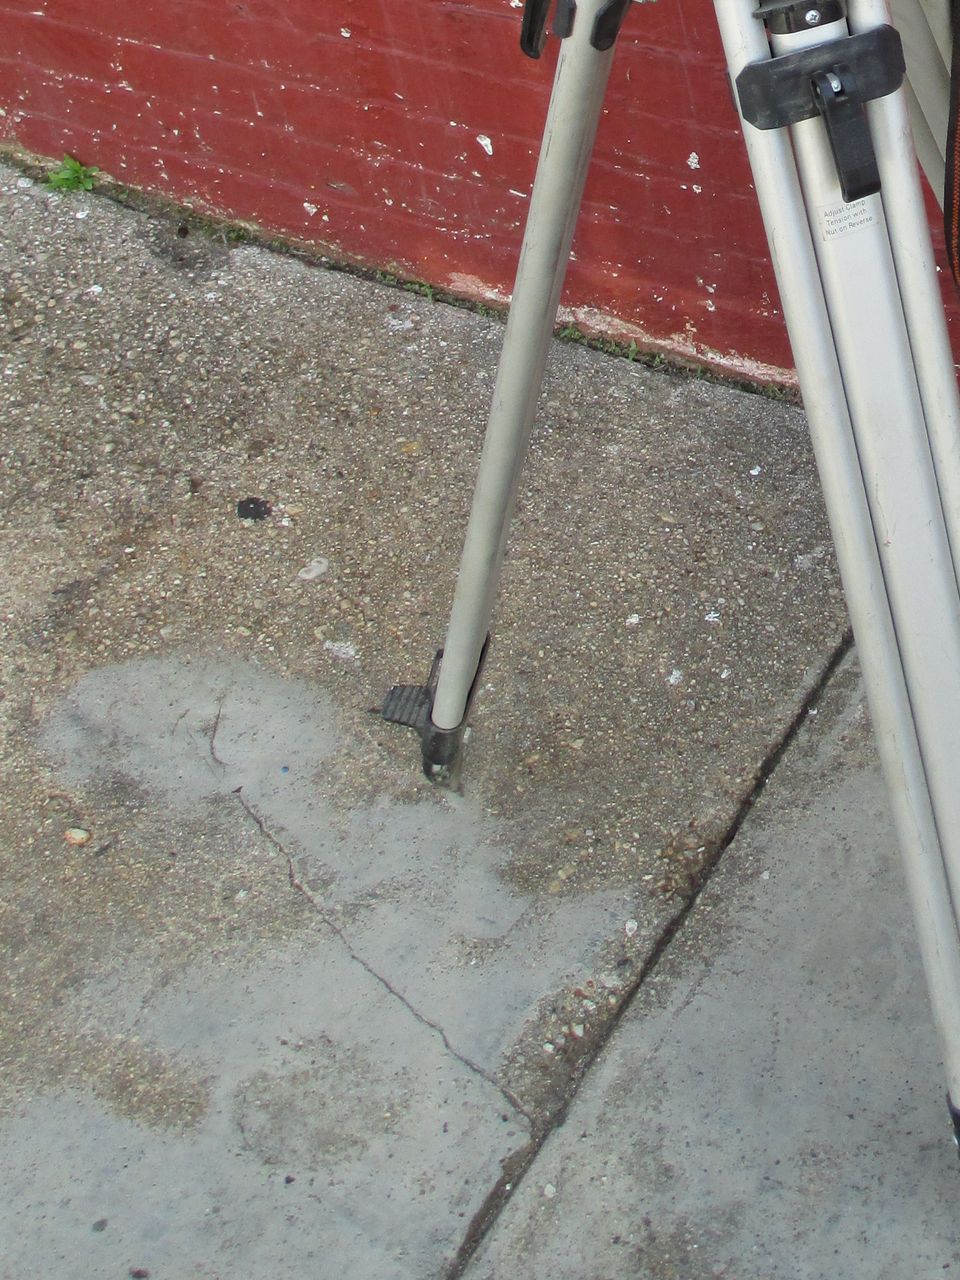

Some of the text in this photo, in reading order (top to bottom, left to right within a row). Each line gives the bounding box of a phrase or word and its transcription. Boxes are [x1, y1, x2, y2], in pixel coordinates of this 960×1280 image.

[824, 200, 866, 218] Adjust Clamp
[827, 208, 867, 226] Tension with
[826, 216, 873, 236] Nut on Reverse
